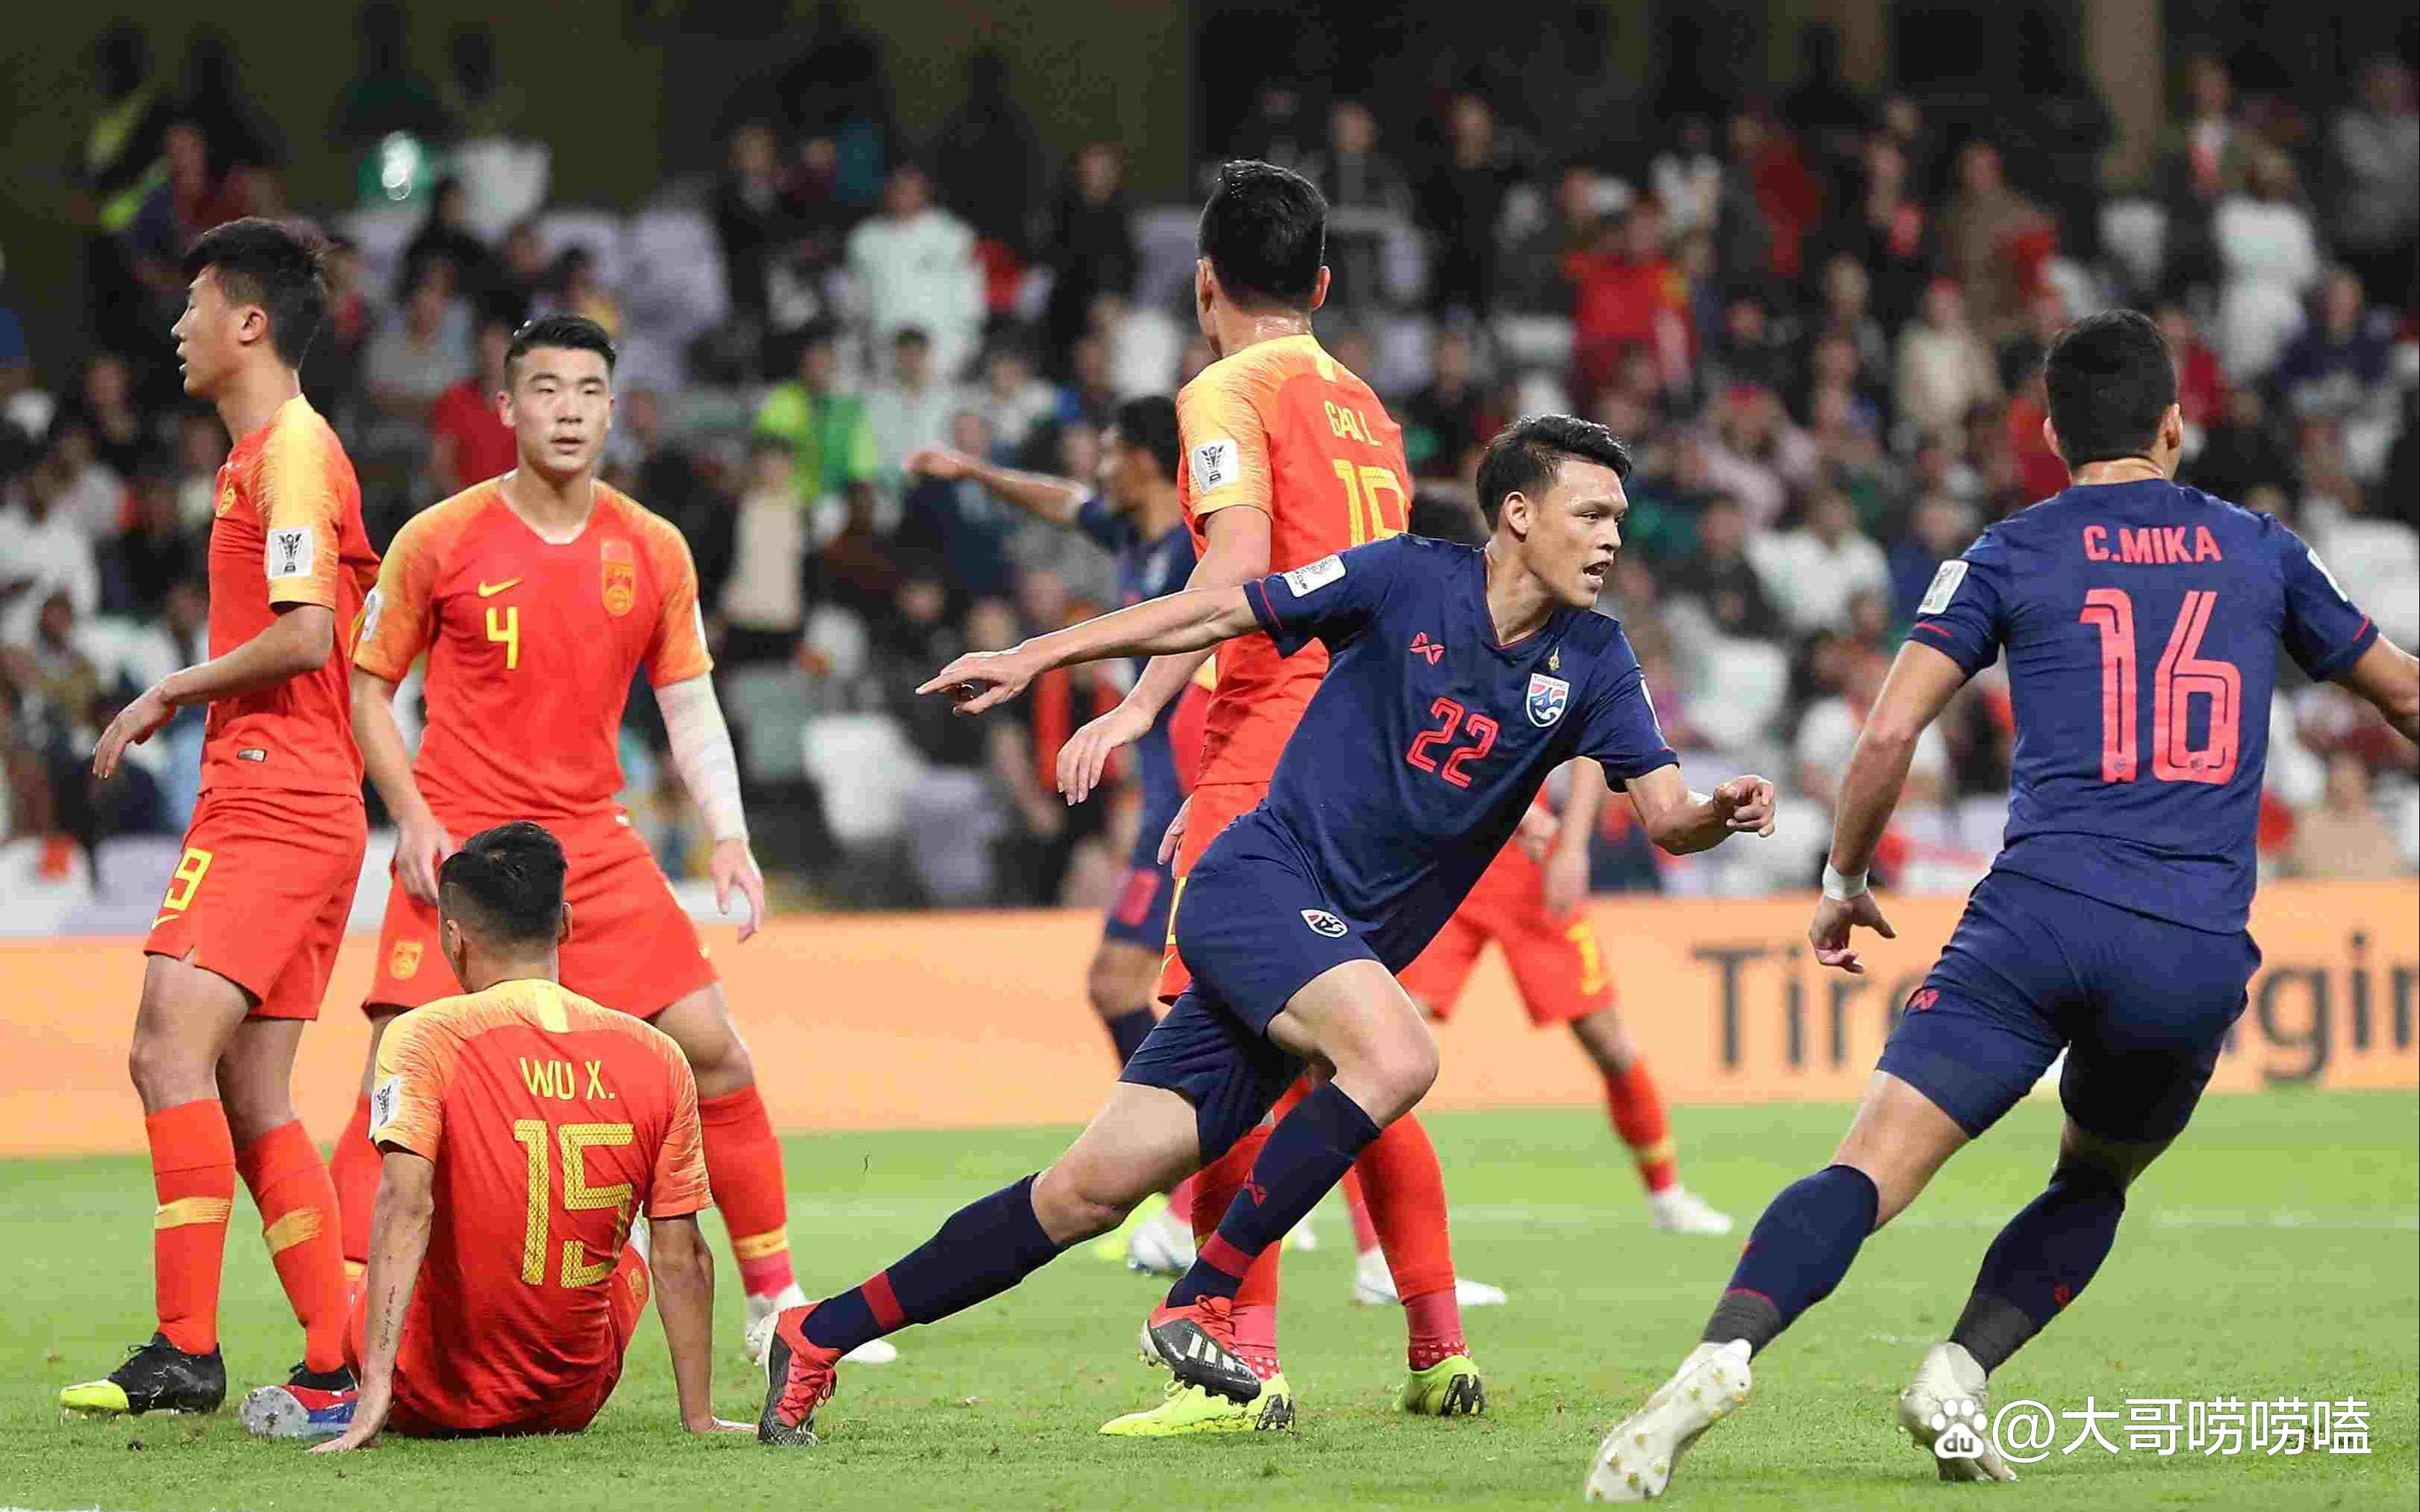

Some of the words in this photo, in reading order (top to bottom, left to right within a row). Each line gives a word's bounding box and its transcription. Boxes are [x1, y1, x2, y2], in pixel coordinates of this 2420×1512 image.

[2083, 525, 2222, 564] C.MIKA
[485, 606, 519, 670] 4
[2079, 588, 2242, 784] 16
[1406, 697, 1499, 788] 22
[163, 847, 214, 912] 9
[519, 1057, 575, 1100] WU
[585, 1060, 615, 1100] X.
[514, 1119, 634, 1288] 15
